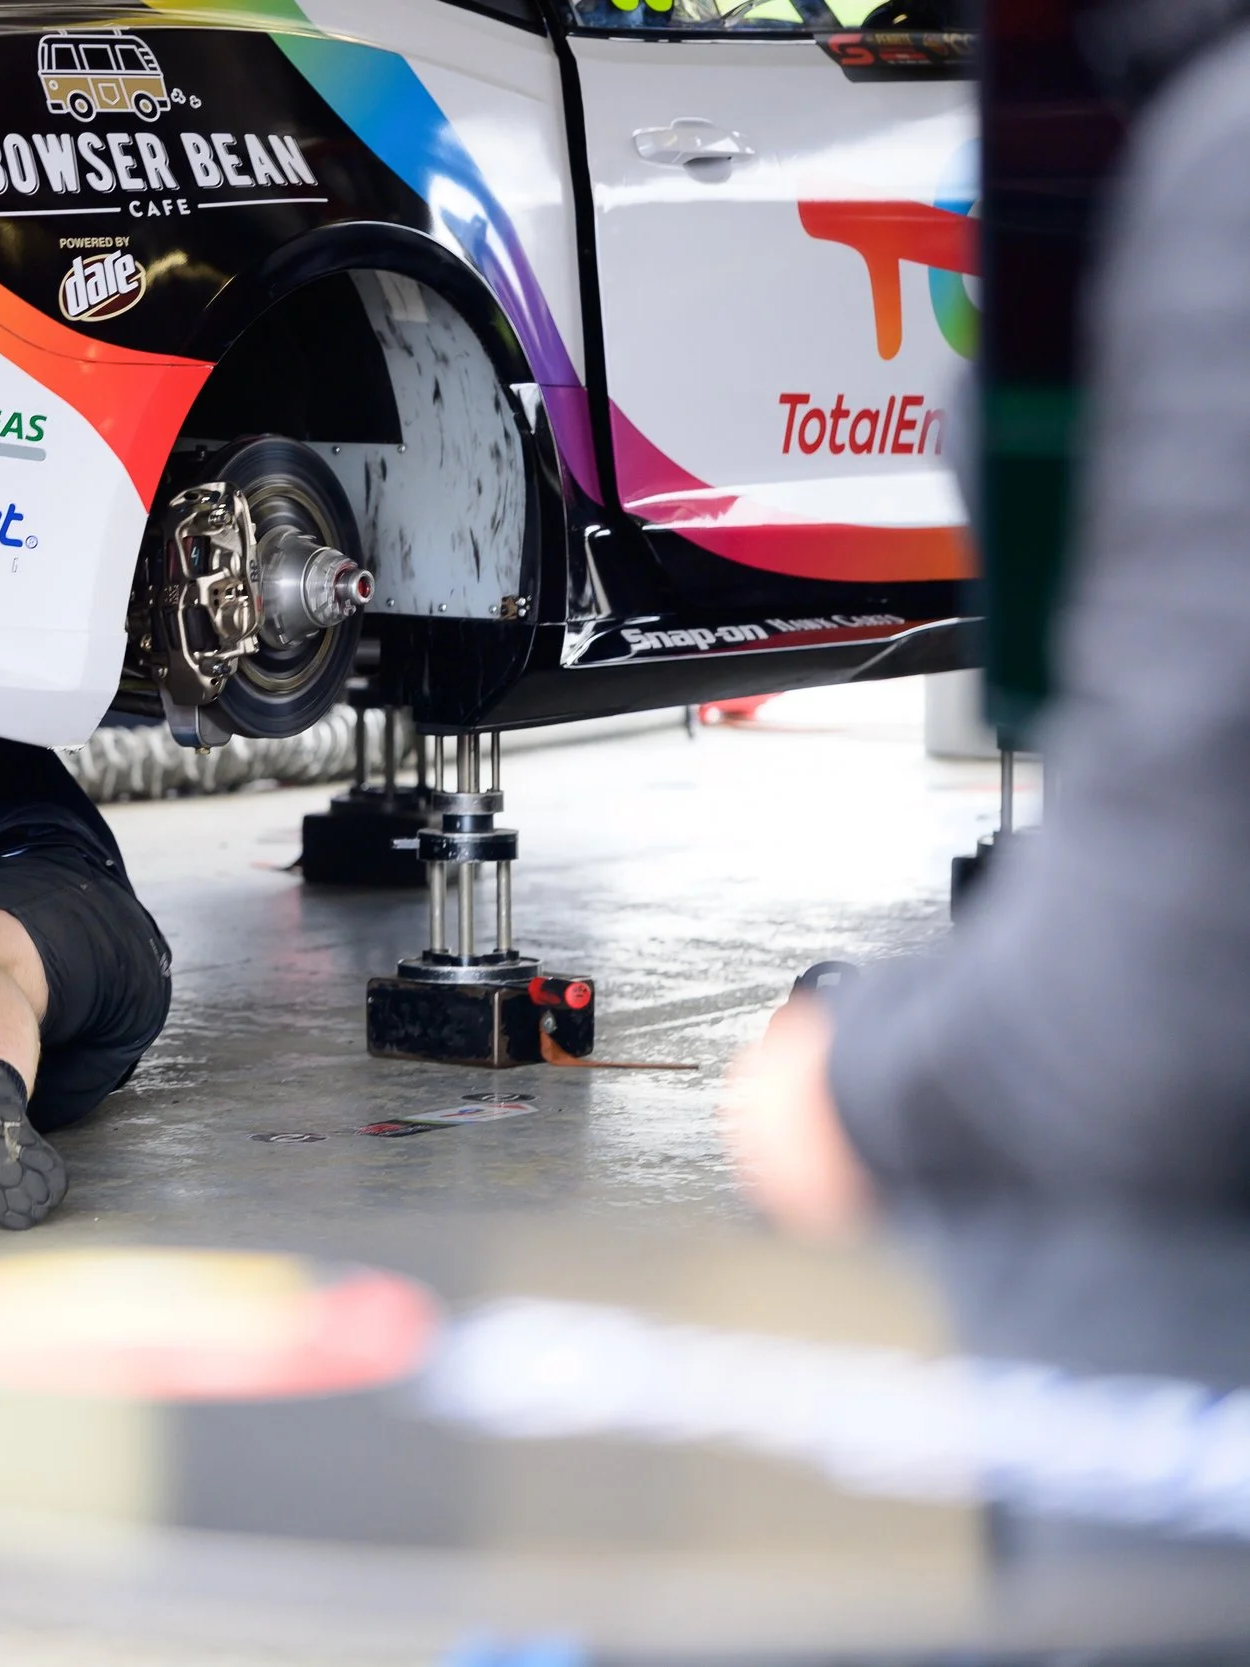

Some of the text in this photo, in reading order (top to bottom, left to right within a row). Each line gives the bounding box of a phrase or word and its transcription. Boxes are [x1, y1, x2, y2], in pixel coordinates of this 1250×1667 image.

[179, 132, 319, 188] BEAN
[129, 198, 191, 218] CAFE
[59, 236, 130, 249] POWERED BY
[64, 249, 140, 318] dare
[620, 623, 770, 650] Snap-on
